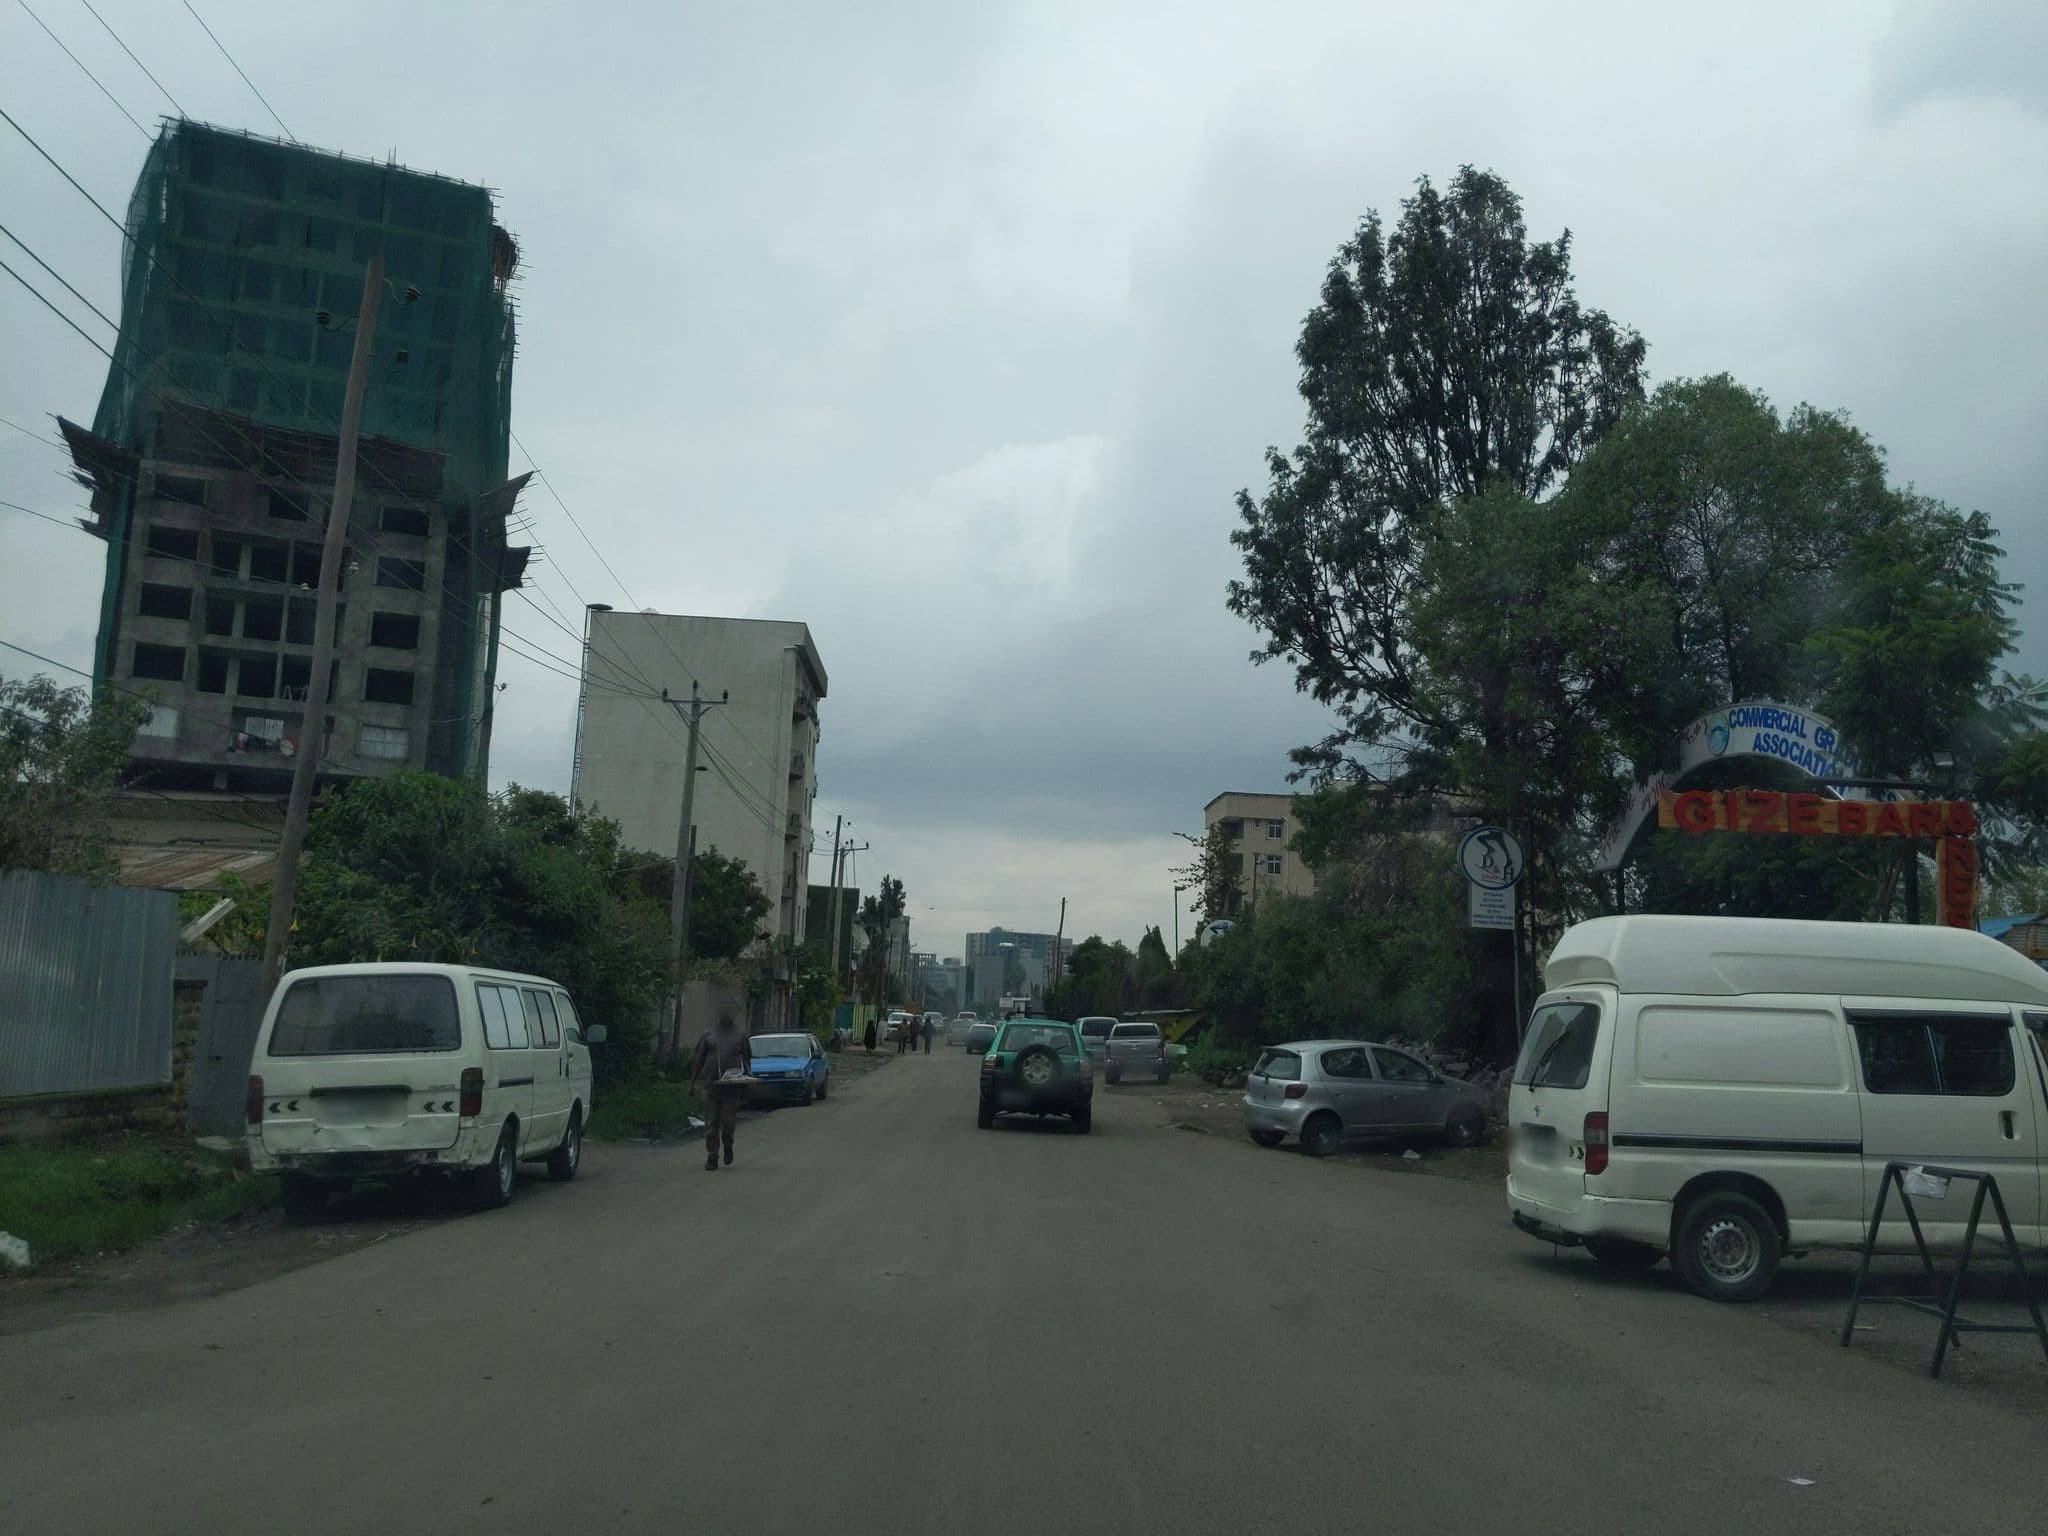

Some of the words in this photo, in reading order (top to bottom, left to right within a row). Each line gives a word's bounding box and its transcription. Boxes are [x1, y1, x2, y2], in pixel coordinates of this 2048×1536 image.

[1728, 706, 1807, 739] COMMERCIAL
[1673, 789, 1823, 834] GIZE
[1838, 801, 1943, 838] BAR
